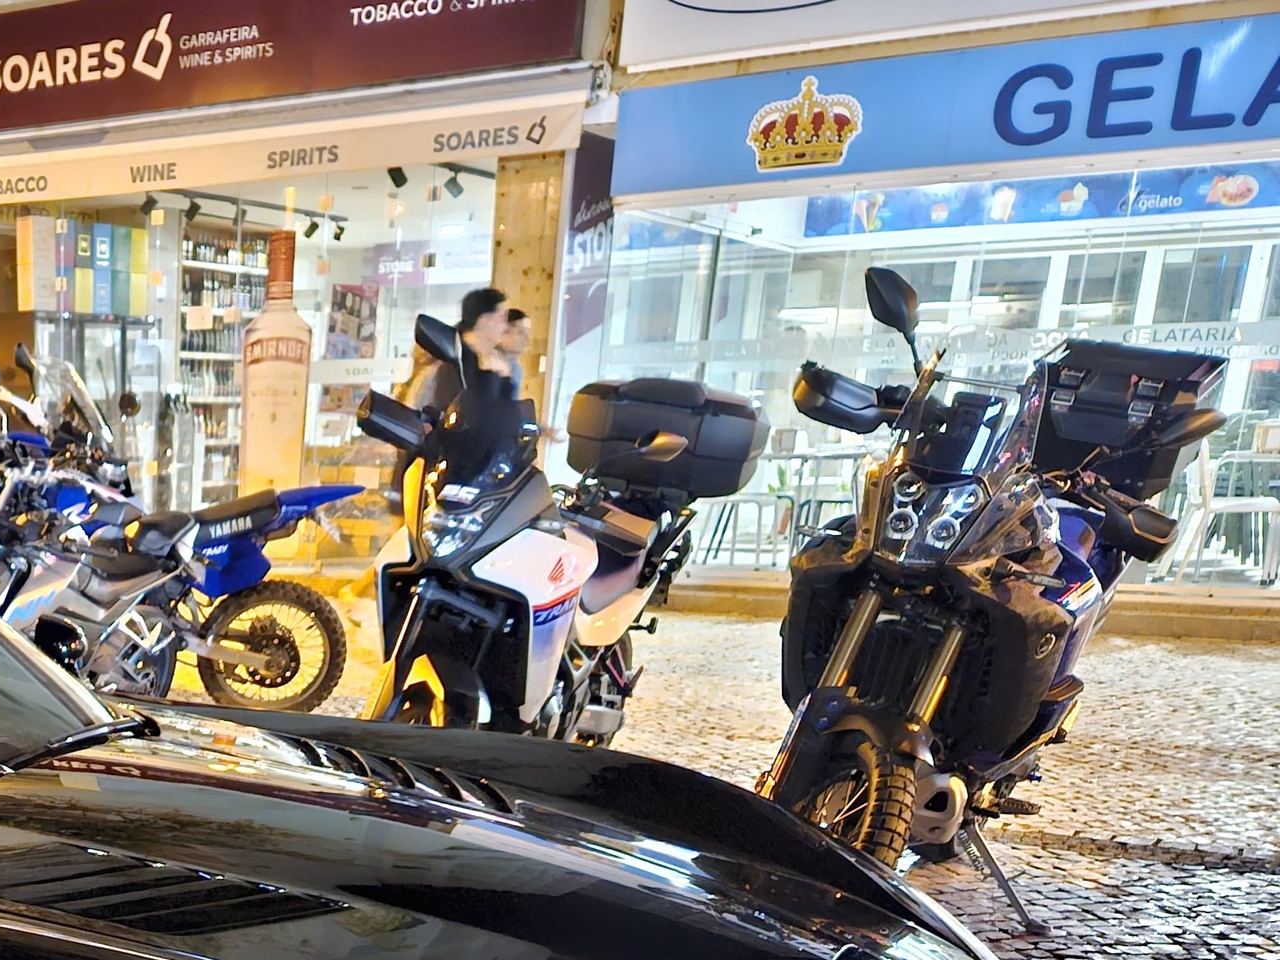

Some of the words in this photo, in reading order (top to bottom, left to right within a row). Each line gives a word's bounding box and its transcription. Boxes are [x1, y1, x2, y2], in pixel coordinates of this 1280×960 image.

[350, 0, 442, 25] TOBACCO
[179, 25, 260, 49] GARRAFEIRA
[178, 50, 212, 69] WINE
[213, 49, 224, 65] &
[225, 42, 274, 63] SPIRITS
[433, 125, 519, 152] SOARES
[266, 145, 340, 169] SPIRITS
[130, 163, 177, 184] WINE
[1138, 194, 1183, 212] gelato
[1122, 326, 1242, 344] GELATARIA
[209, 515, 253, 539] YAMAHA
